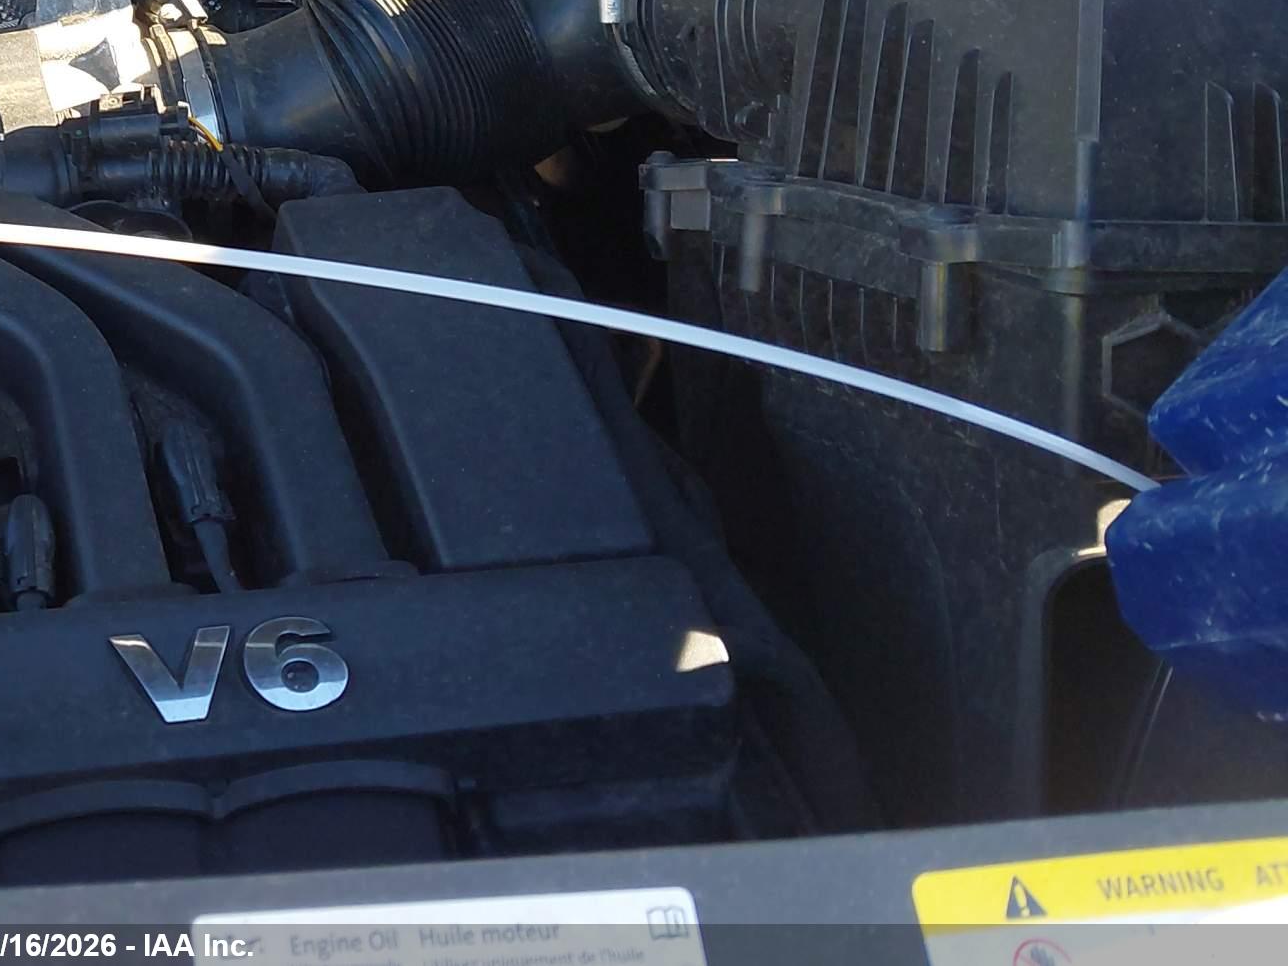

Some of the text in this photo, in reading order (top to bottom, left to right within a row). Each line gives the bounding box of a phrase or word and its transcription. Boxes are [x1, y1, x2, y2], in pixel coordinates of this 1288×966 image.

[109, 617, 348, 723] V6
[1098, 866, 1225, 901] WARNING
[289, 928, 400, 961] Engine Oil
[418, 923, 560, 948] Huile moteur
